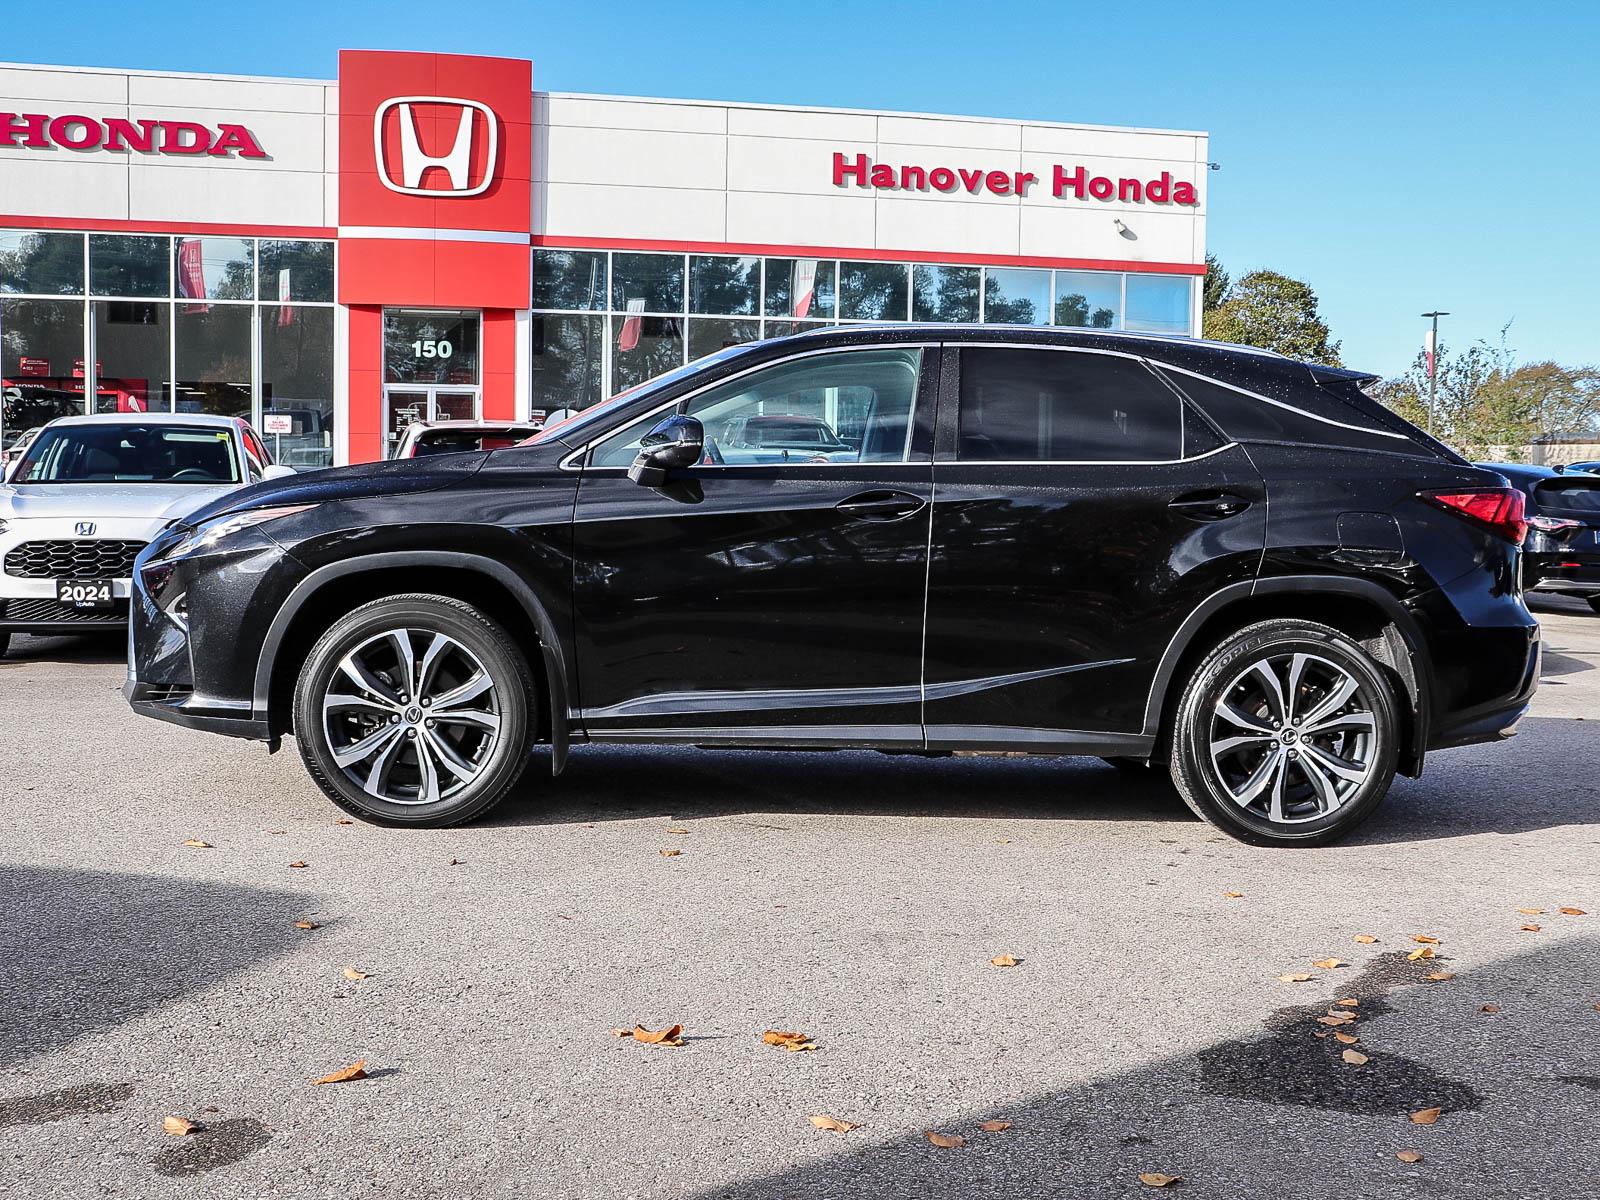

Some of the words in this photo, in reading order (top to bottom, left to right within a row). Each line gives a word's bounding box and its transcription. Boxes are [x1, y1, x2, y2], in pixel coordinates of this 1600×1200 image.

[0, 112, 266, 158] HONDA
[832, 152, 1035, 196] Hanover
[1052, 164, 1197, 205] Honda
[411, 340, 453, 359] 150
[60, 585, 110, 601] 2024
